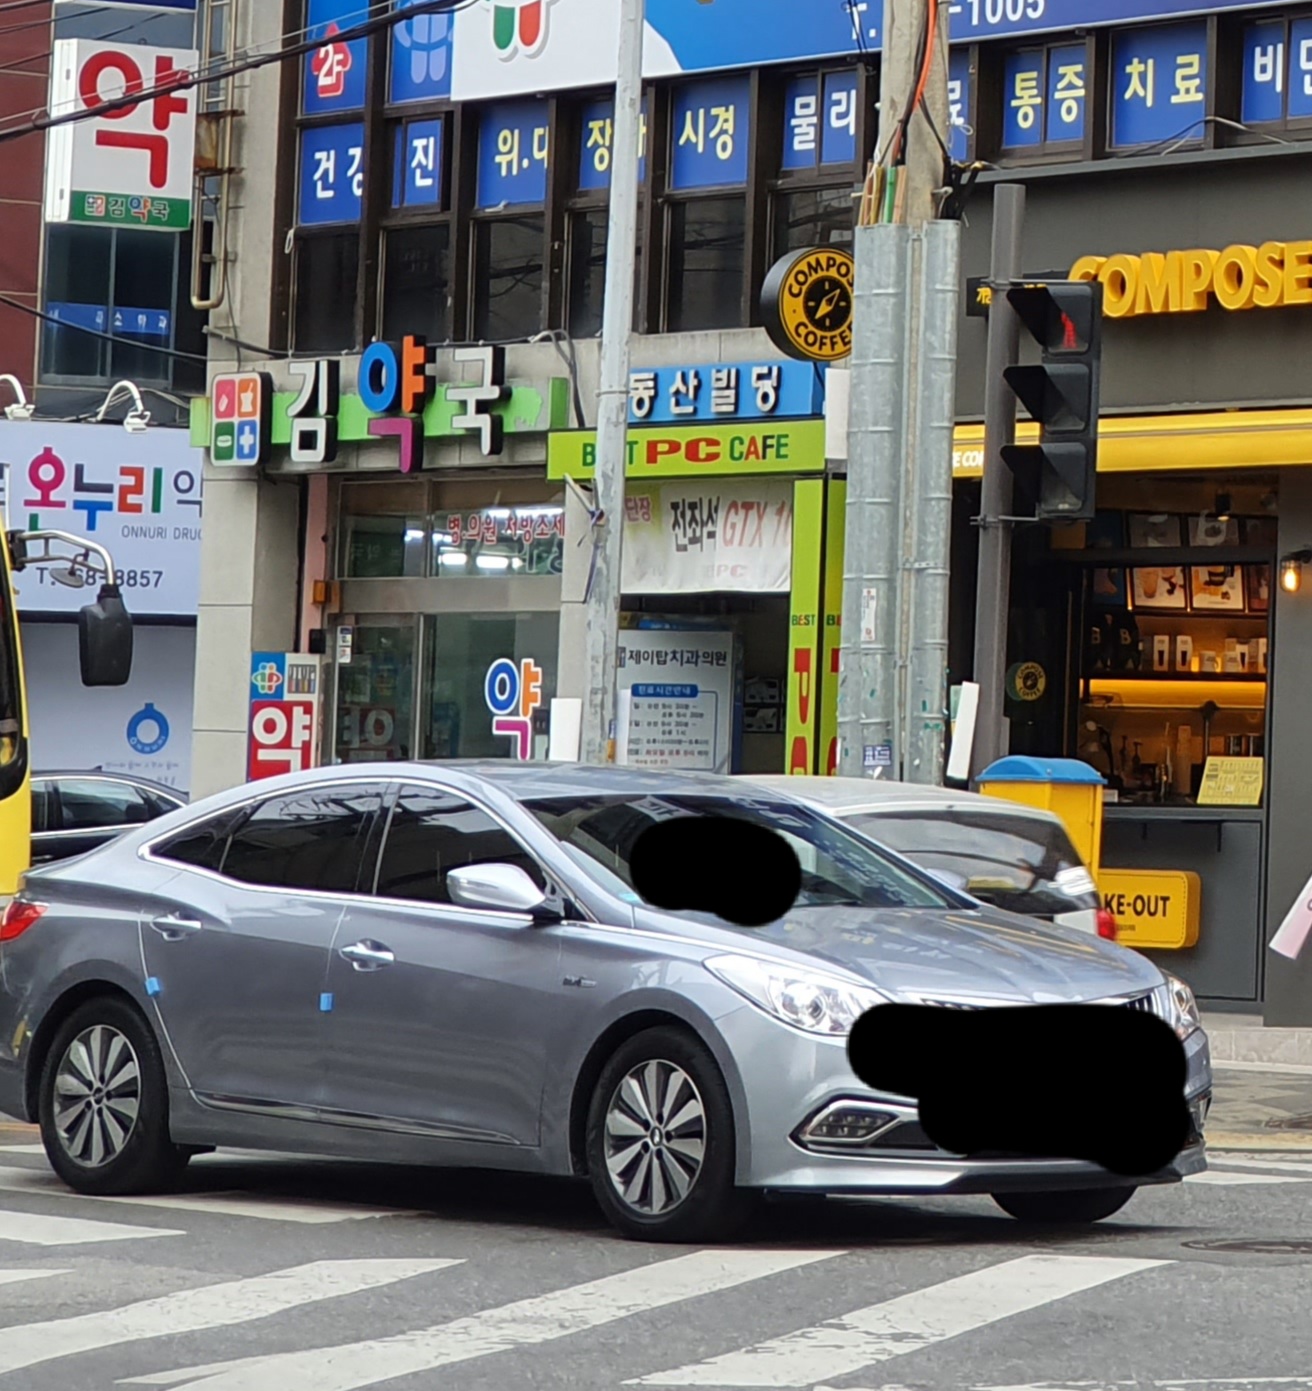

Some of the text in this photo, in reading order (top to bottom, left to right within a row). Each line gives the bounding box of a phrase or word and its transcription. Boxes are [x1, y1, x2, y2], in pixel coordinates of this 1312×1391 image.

[317, 45, 343, 86] 2F
[79, 50, 188, 189] 약
[108, 195, 169, 223] 김약국
[788, 256, 855, 299] COMPO
[287, 335, 504, 473] 김약국
[629, 365, 783, 419] 동산빌딩
[646, 437, 721, 464] PC
[729, 433, 790, 462] CAFE
[121, 525, 168, 540] ONNURI
[670, 496, 721, 553] 전좌석
[722, 499, 769, 548] GTX
[791, 614, 816, 626] BEST
[628, 649, 727, 668] 제이탑치과의원
[485, 658, 543, 762] 약
[252, 706, 311, 773] 약
[1104, 893, 1171, 918] KE-OUT
